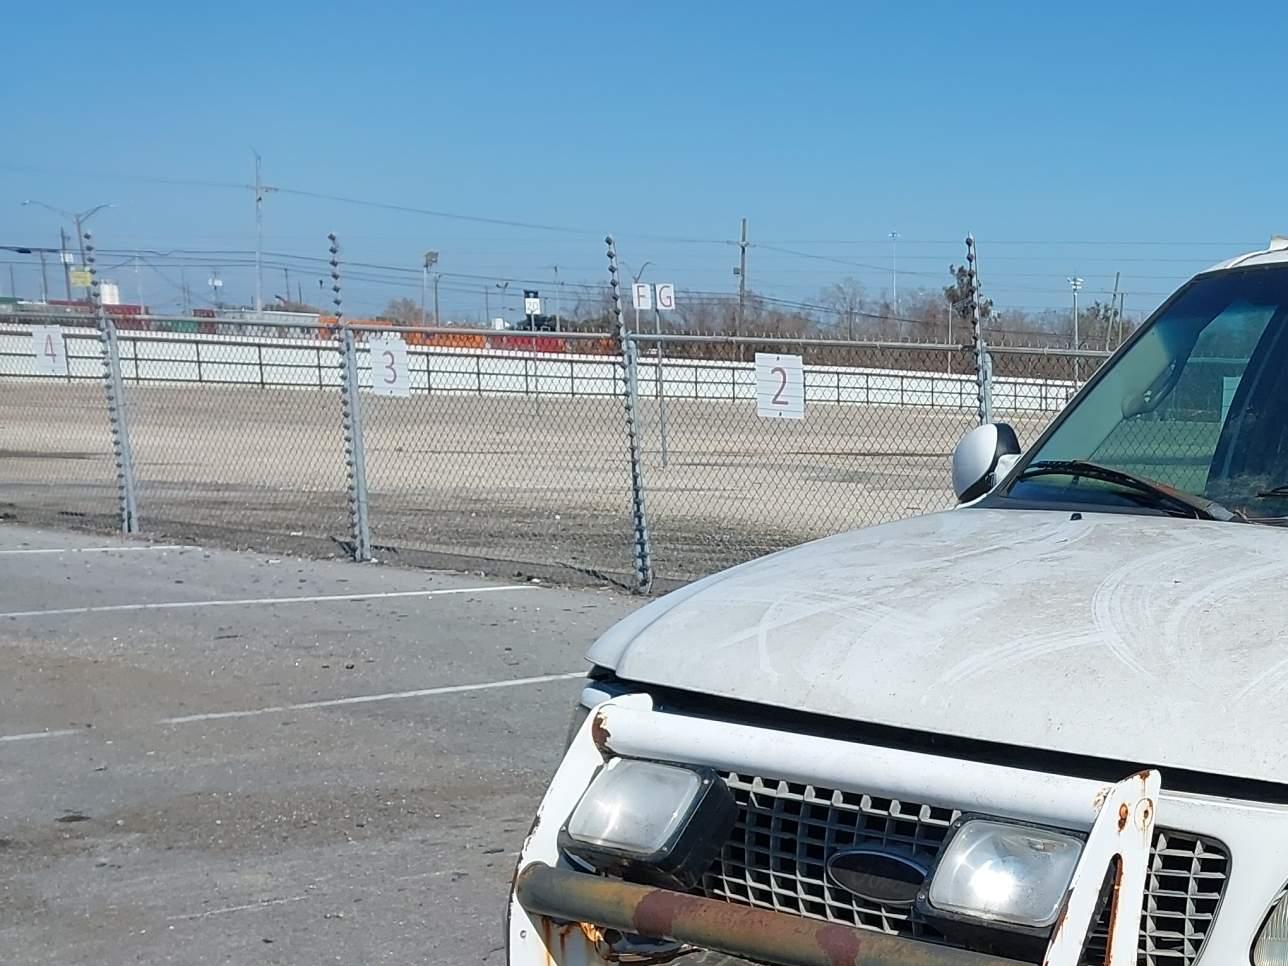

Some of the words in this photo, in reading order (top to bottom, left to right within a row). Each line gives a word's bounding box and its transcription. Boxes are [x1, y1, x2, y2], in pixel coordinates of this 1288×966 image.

[637, 284, 647, 308] F
[658, 285, 672, 308] G
[44, 334, 57, 364] 4
[383, 354, 398, 385] 3
[770, 366, 790, 406] 2
